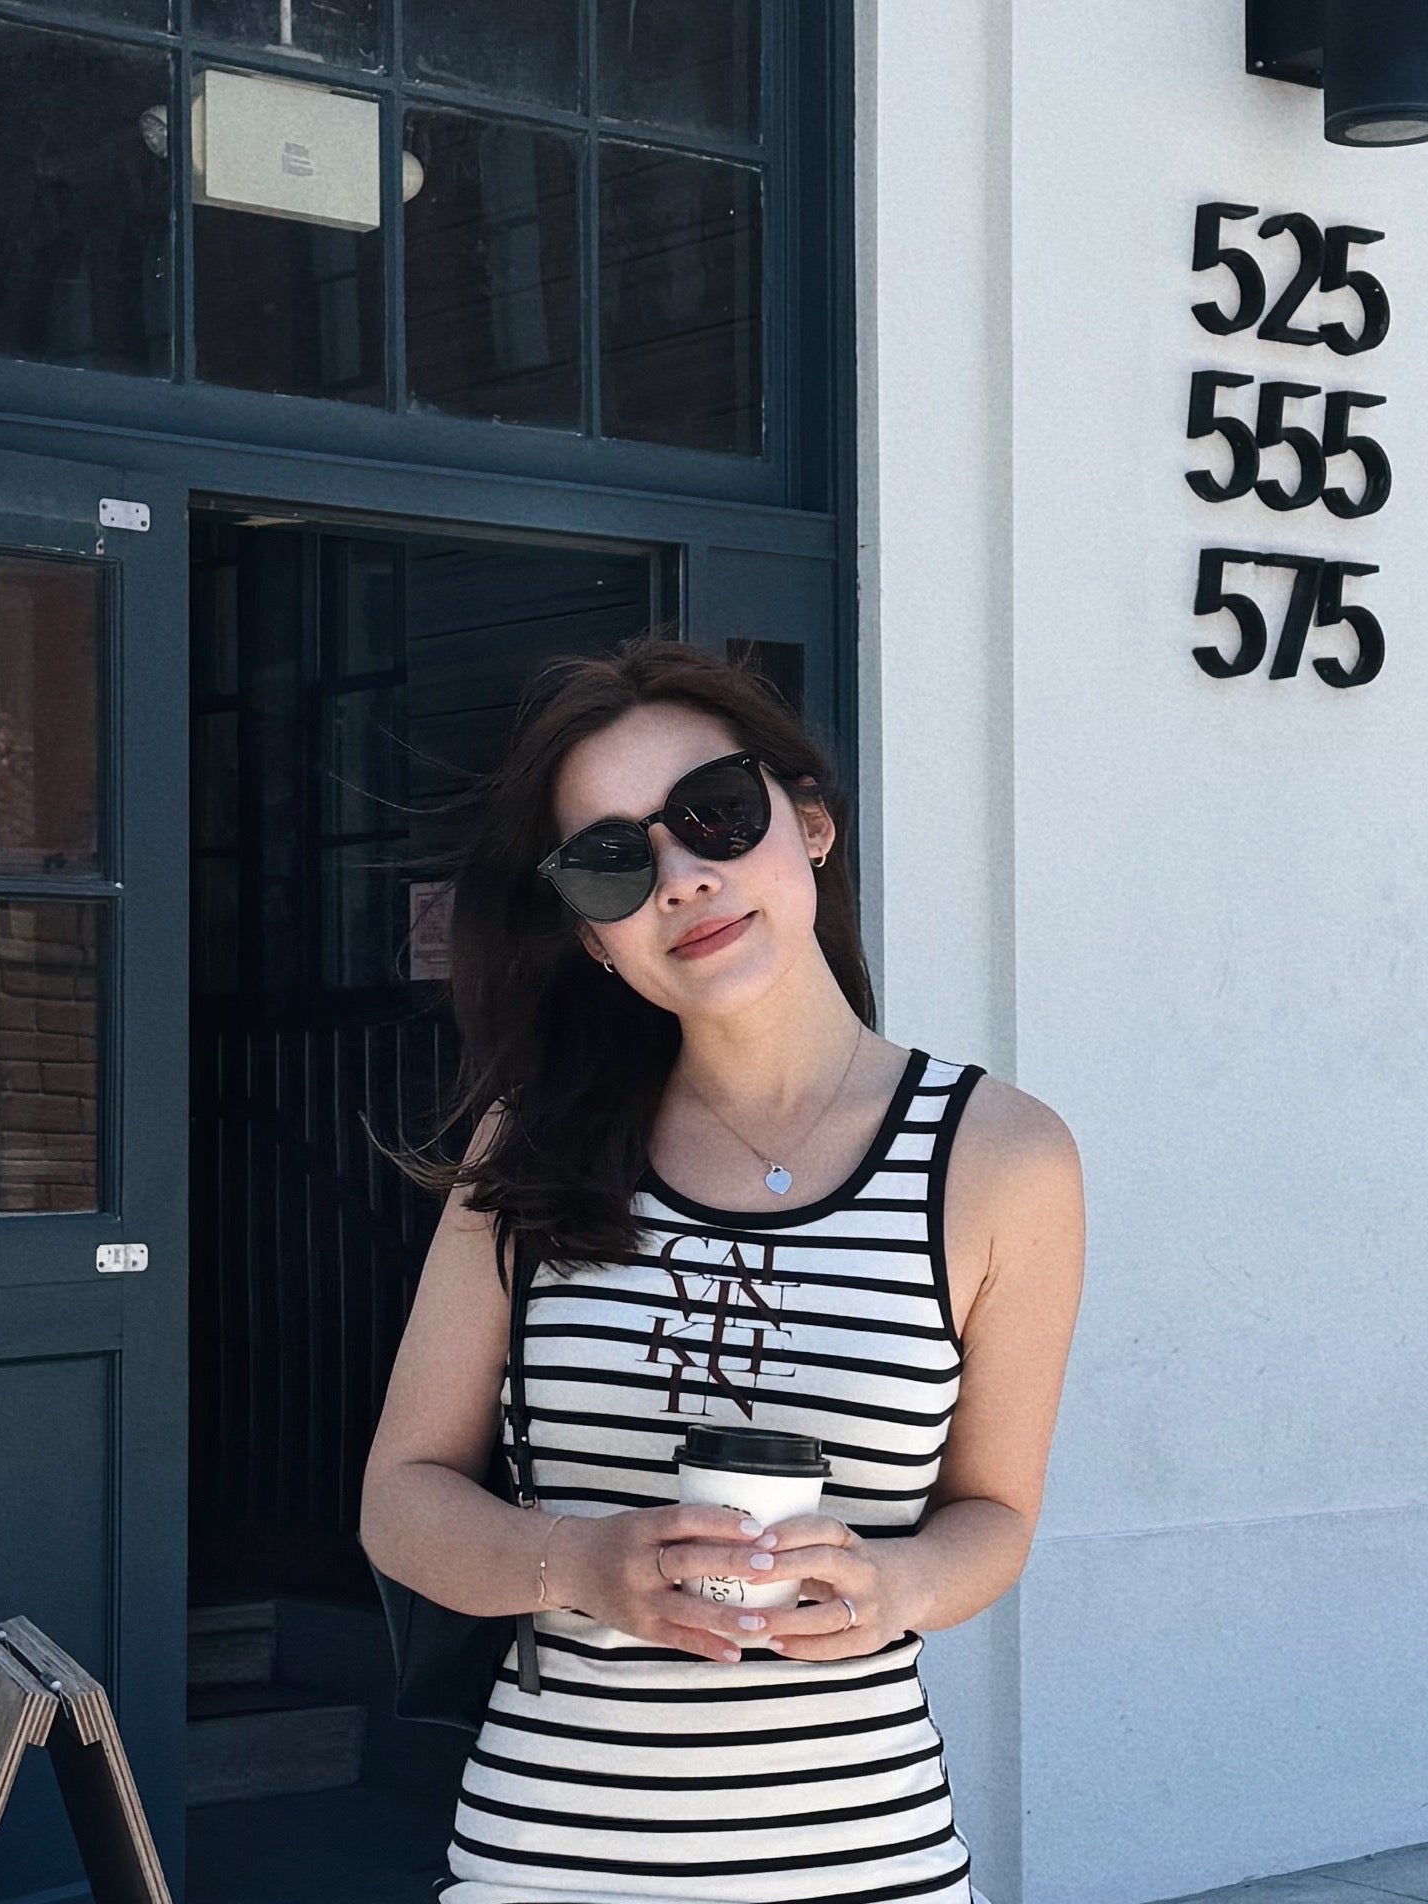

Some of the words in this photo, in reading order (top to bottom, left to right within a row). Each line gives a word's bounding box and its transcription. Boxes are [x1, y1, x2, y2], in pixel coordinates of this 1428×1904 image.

[1191, 201, 1390, 356] 525
[1185, 369, 1392, 520] 555
[1192, 547, 1385, 689] 575
